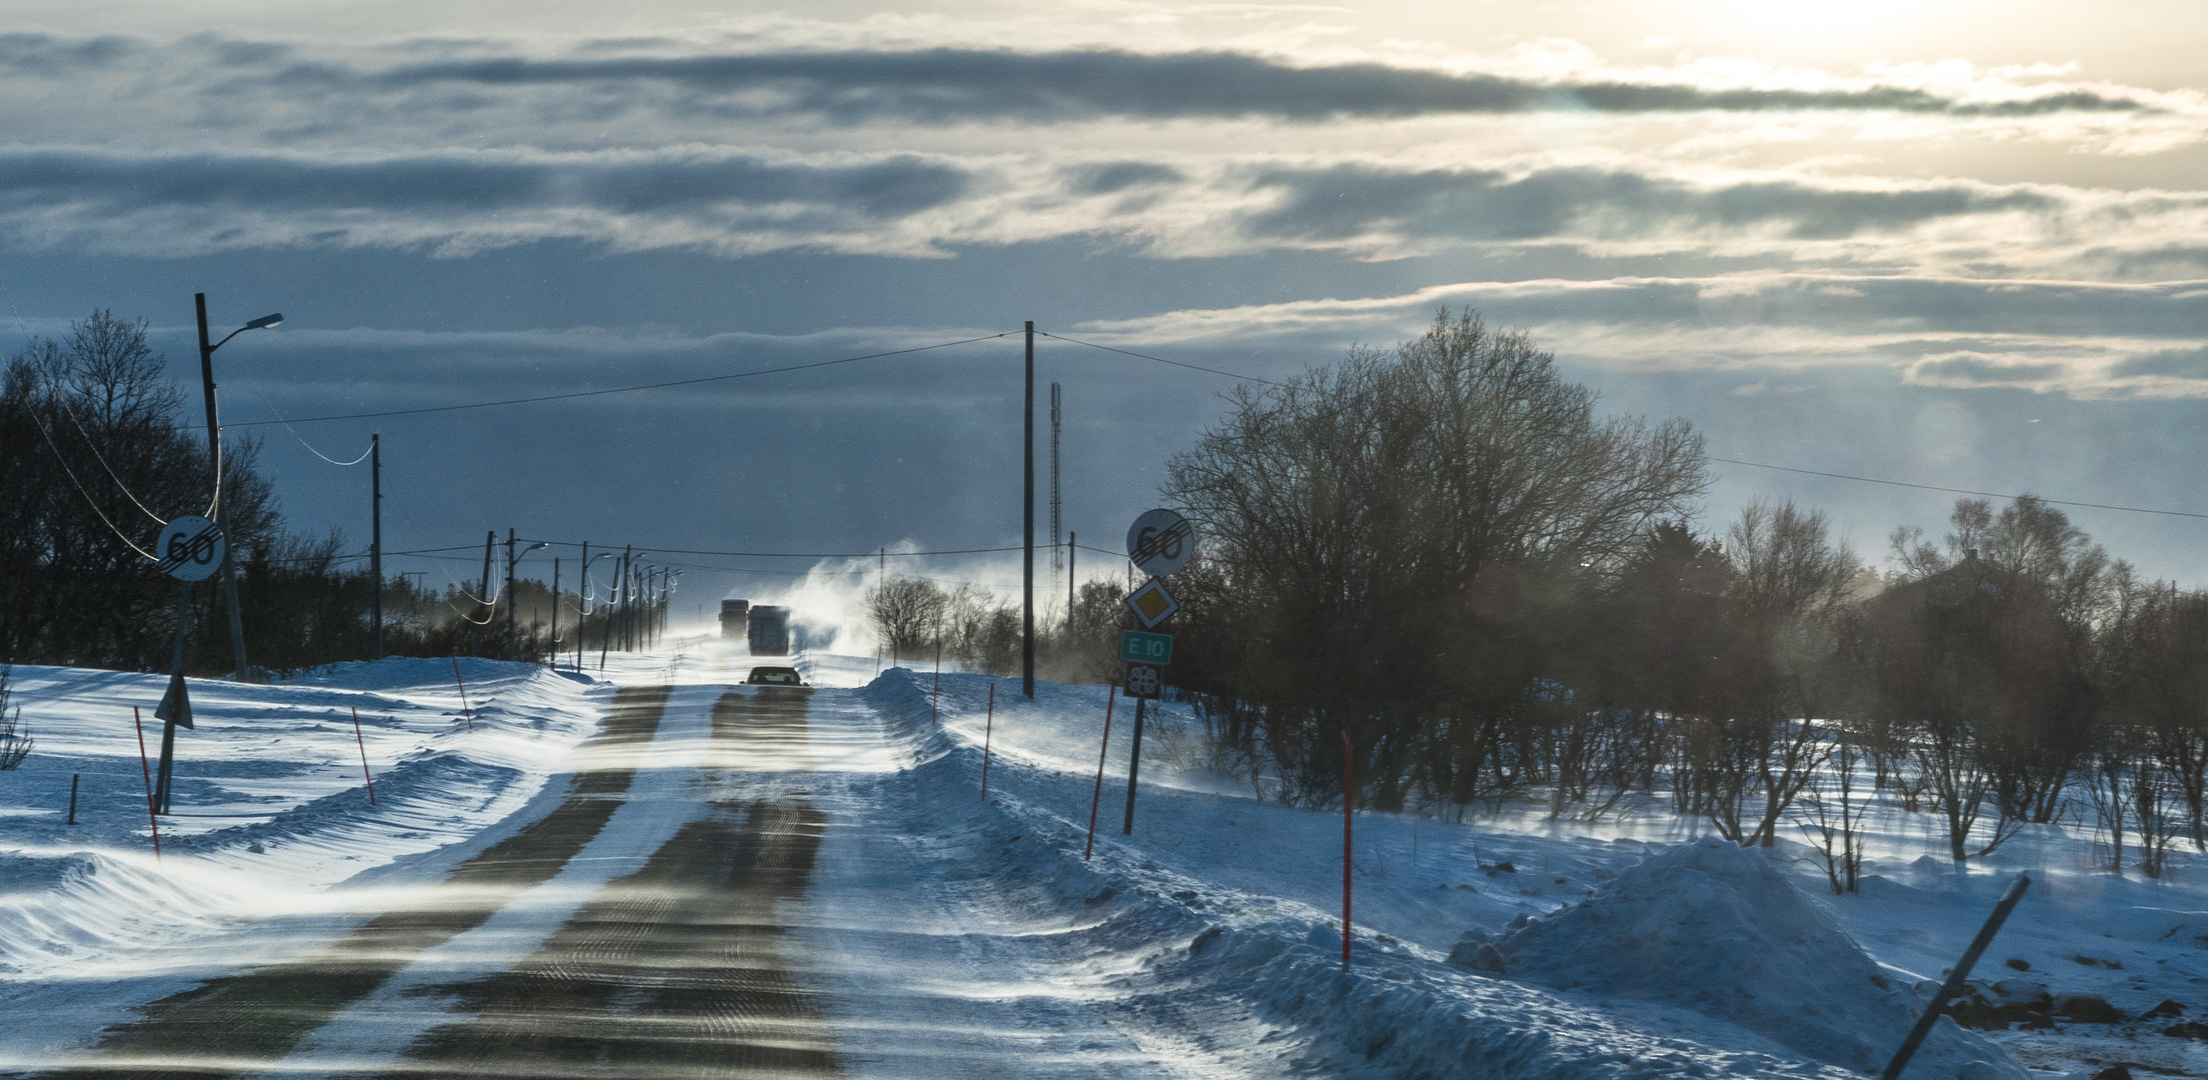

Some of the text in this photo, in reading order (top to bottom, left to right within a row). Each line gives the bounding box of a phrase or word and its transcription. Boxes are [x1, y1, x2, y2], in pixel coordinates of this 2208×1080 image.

[167, 532, 214, 565] 60
[1137, 526, 1183, 560] 60
[1128, 637, 1164, 657] E 10
